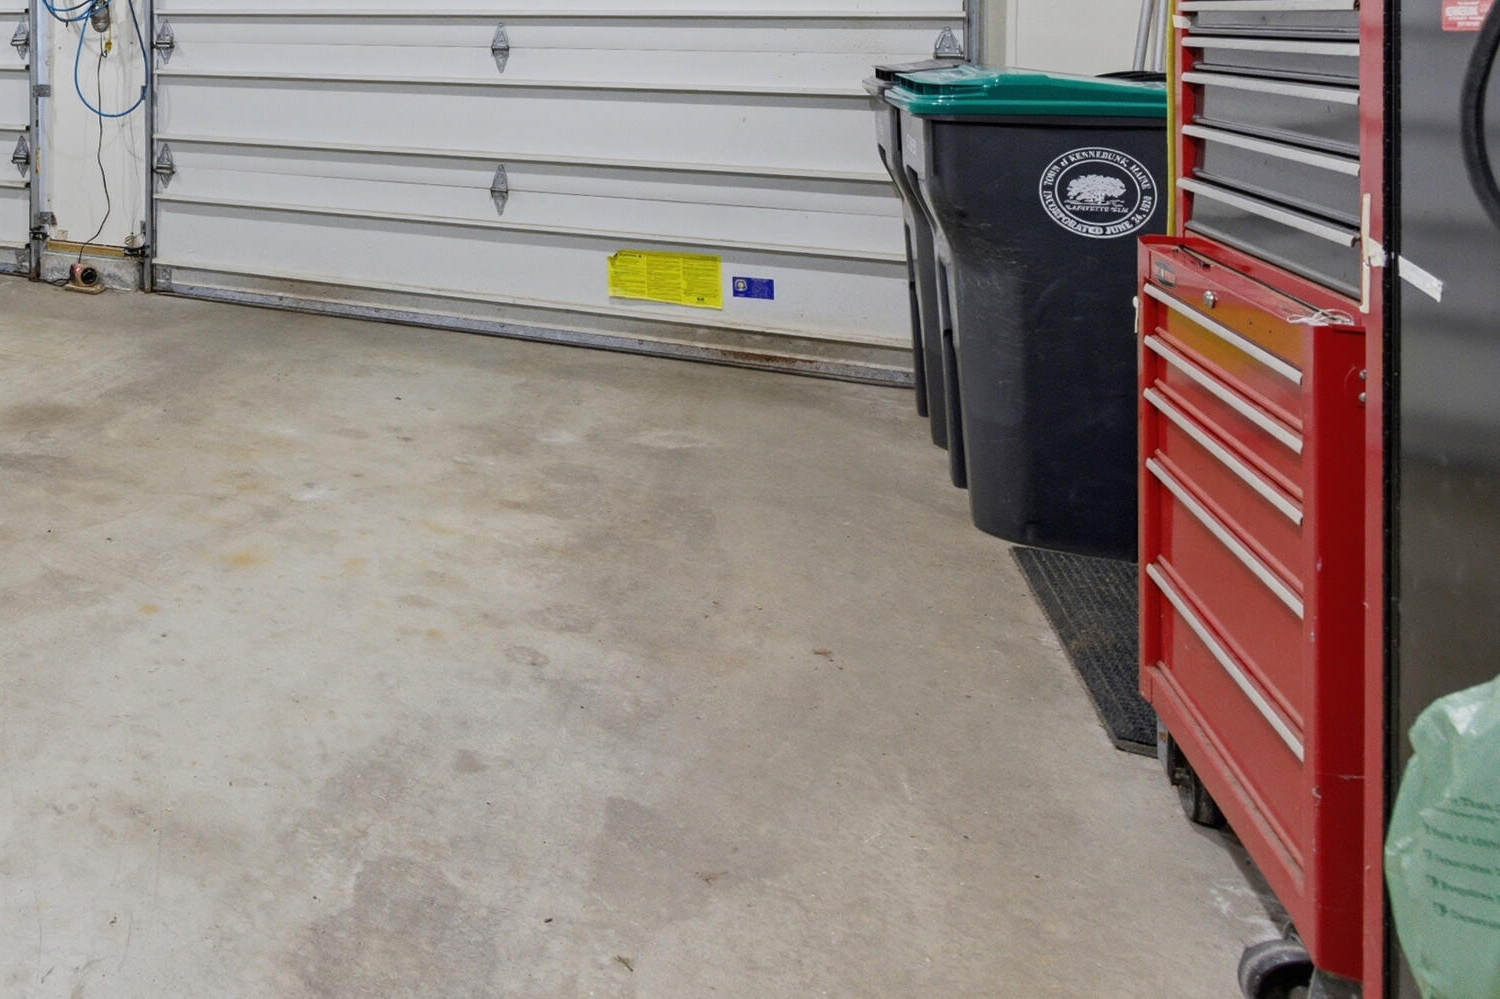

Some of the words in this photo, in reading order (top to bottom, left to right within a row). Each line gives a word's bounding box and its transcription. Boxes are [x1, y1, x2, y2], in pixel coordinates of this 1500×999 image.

[1043, 165, 1061, 186] TOWN
[1069, 151, 1129, 167] KENNEBUNK
[1043, 190, 1104, 235] INCORPORATED
[1105, 221, 1133, 234] JUNE
